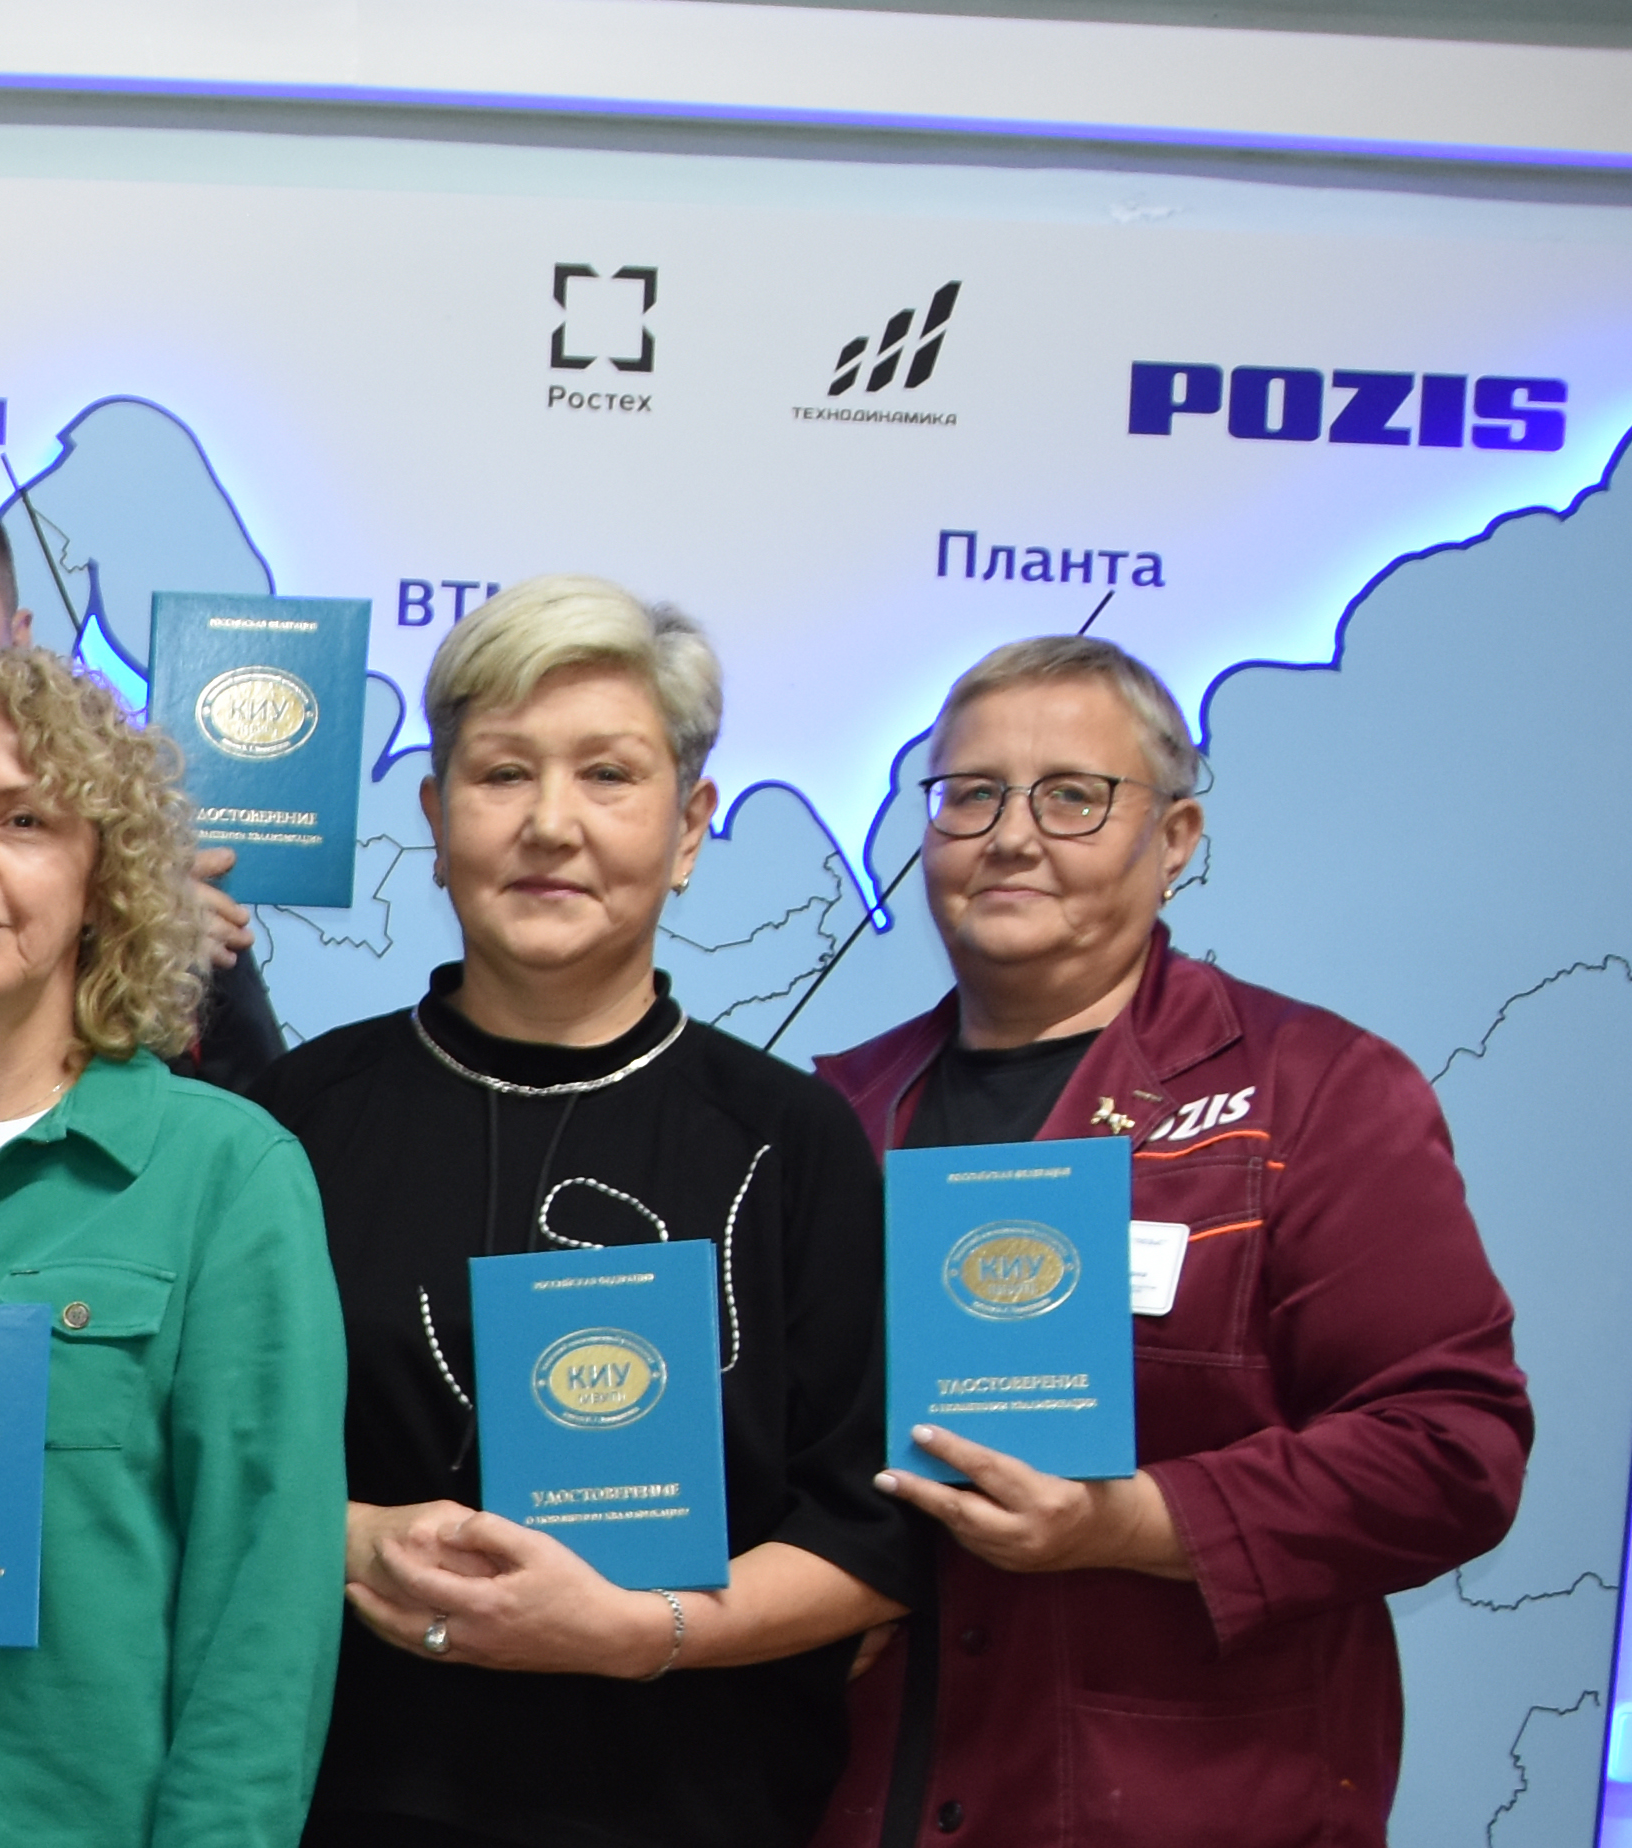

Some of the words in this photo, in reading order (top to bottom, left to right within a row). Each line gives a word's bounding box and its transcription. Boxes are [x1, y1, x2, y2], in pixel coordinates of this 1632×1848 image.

[548, 385, 653, 412] Ростех
[1127, 360, 1569, 452] POZIS
[792, 406, 958, 426] ТЕХНОДИНАМИКА
[937, 529, 1166, 588] Планта
[397, 577, 501, 626] ВТ
[228, 699, 289, 722] КИУ
[196, 807, 317, 826] ДОСТОВЕРЕНИЕ
[978, 1253, 1043, 1282] КИУ
[568, 1361, 632, 1390] КИУ
